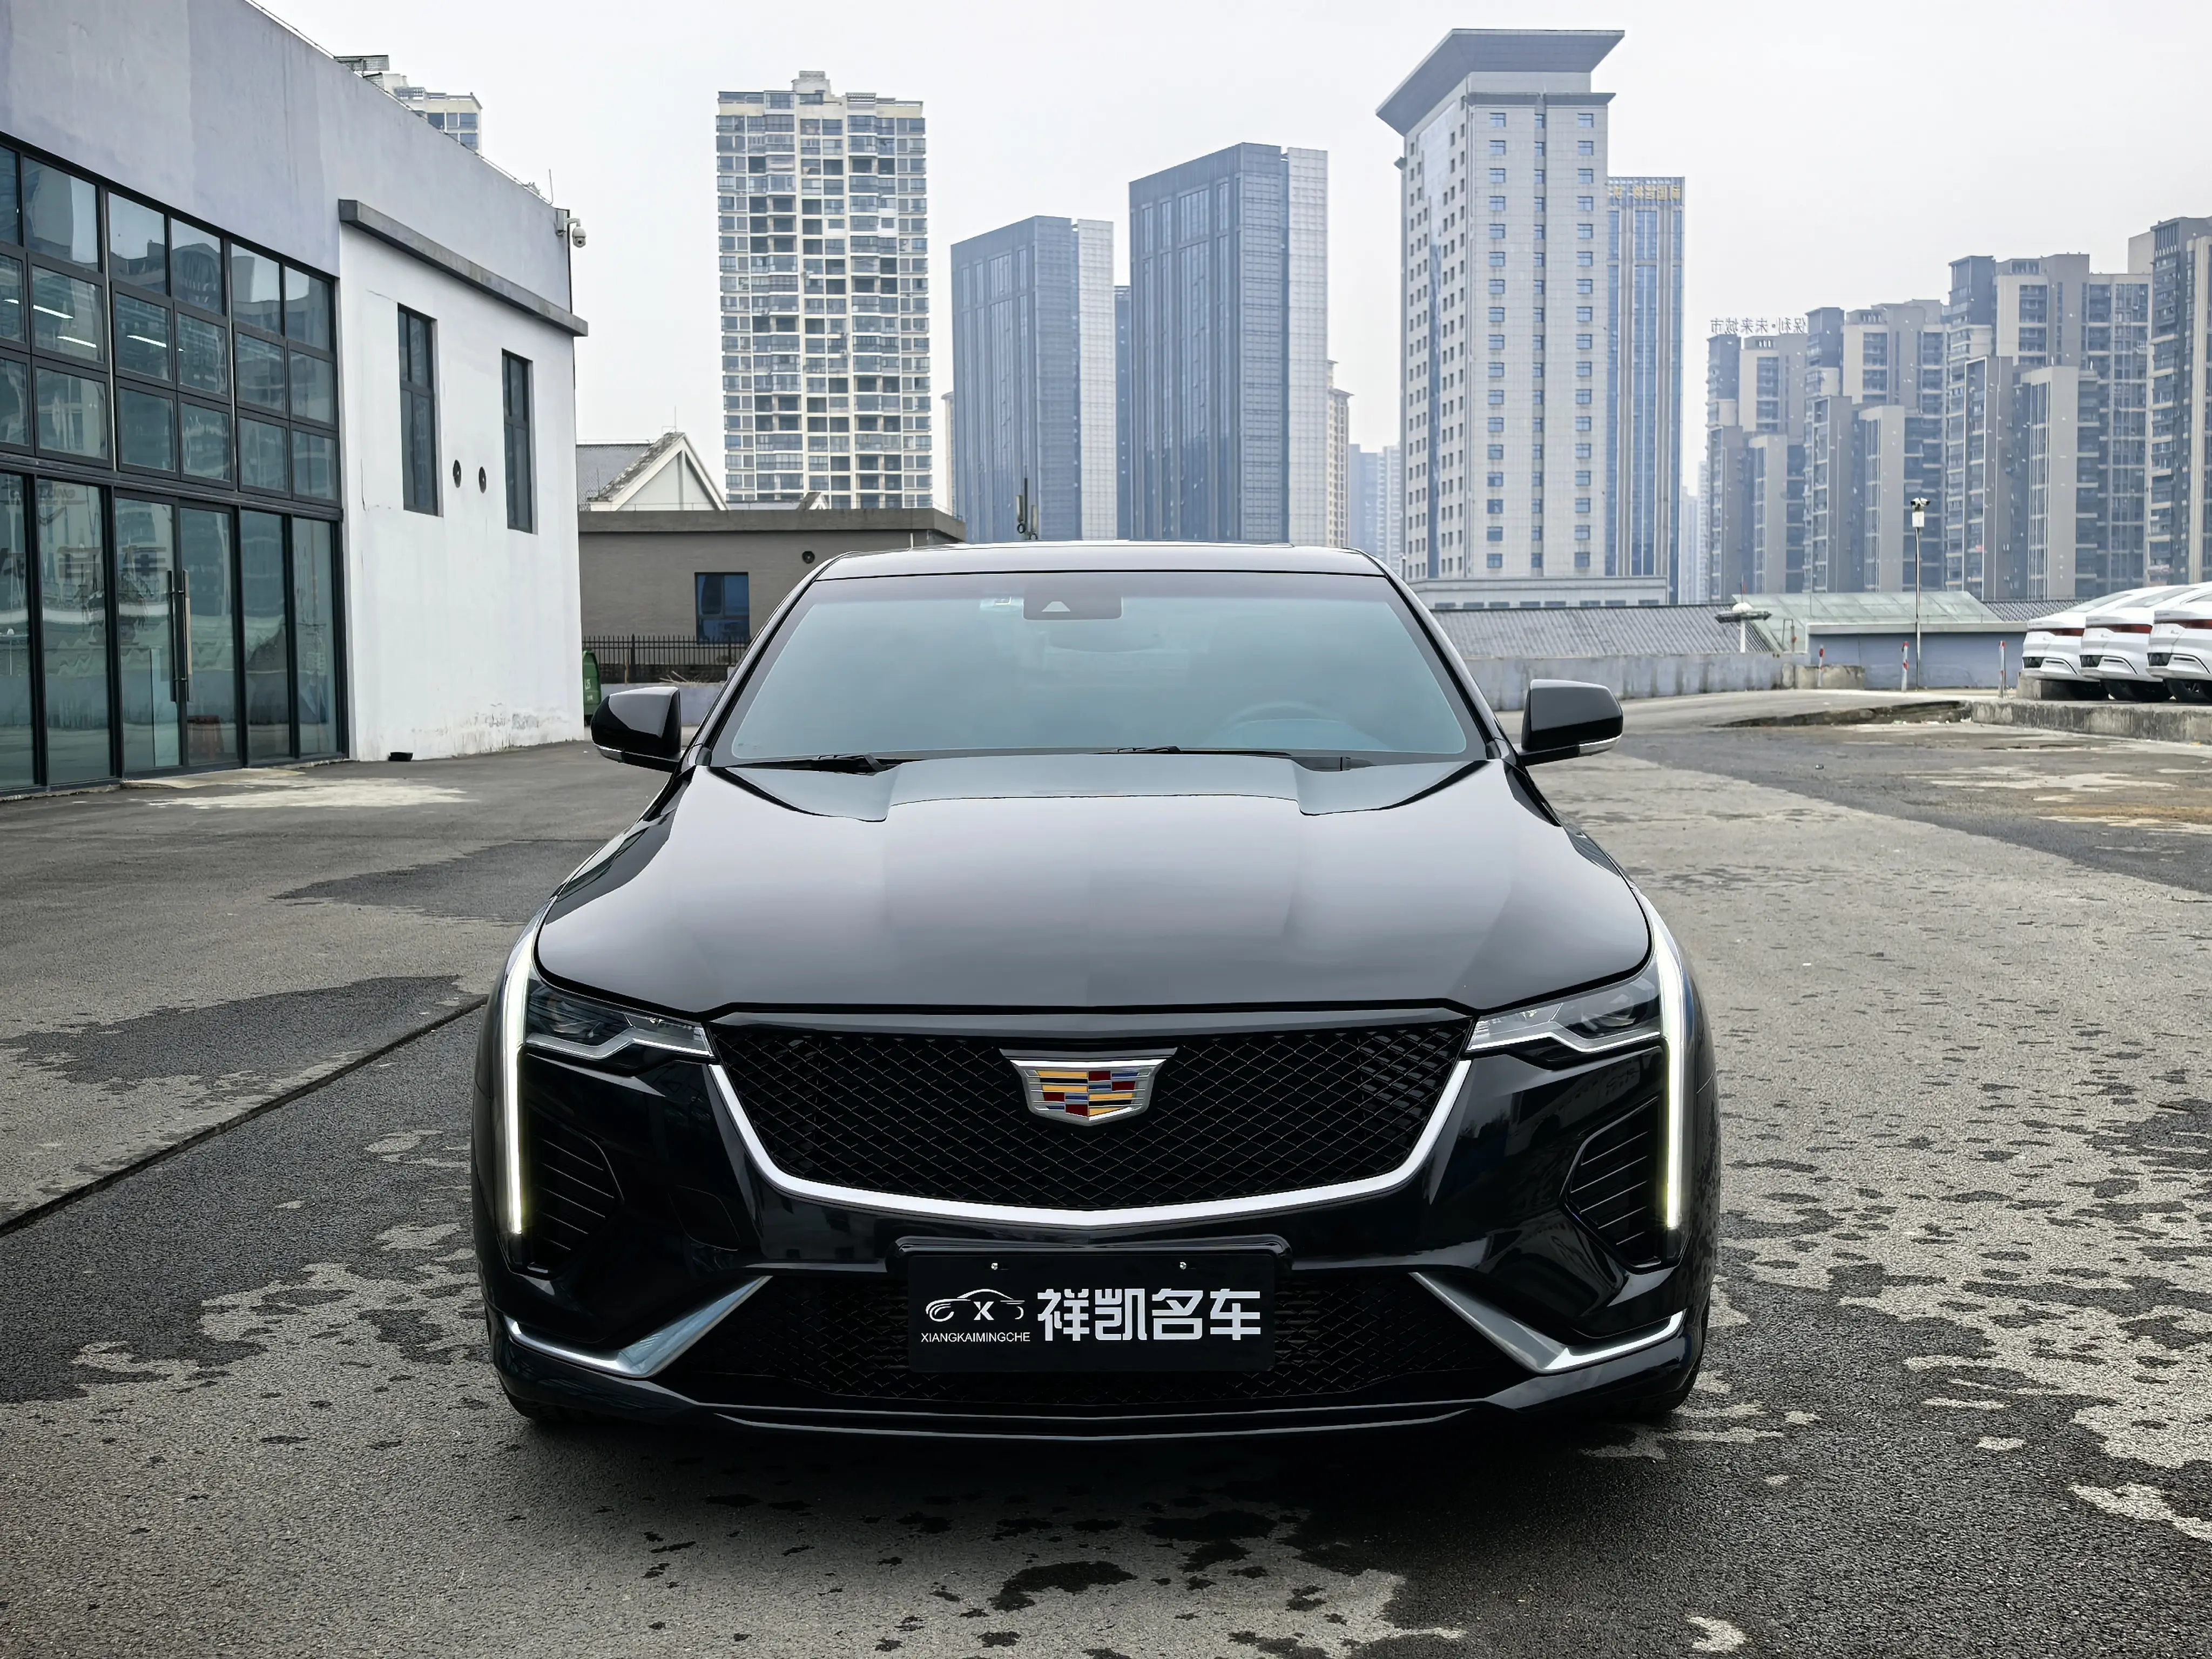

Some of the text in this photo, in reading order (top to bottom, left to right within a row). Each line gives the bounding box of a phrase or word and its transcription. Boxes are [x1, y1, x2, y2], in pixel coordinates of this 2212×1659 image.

[973, 1301, 994, 1321] X
[1037, 1288, 1261, 1341] 祥凯名车
[921, 1332, 1030, 1343] XIANGKAIMINGCHE
